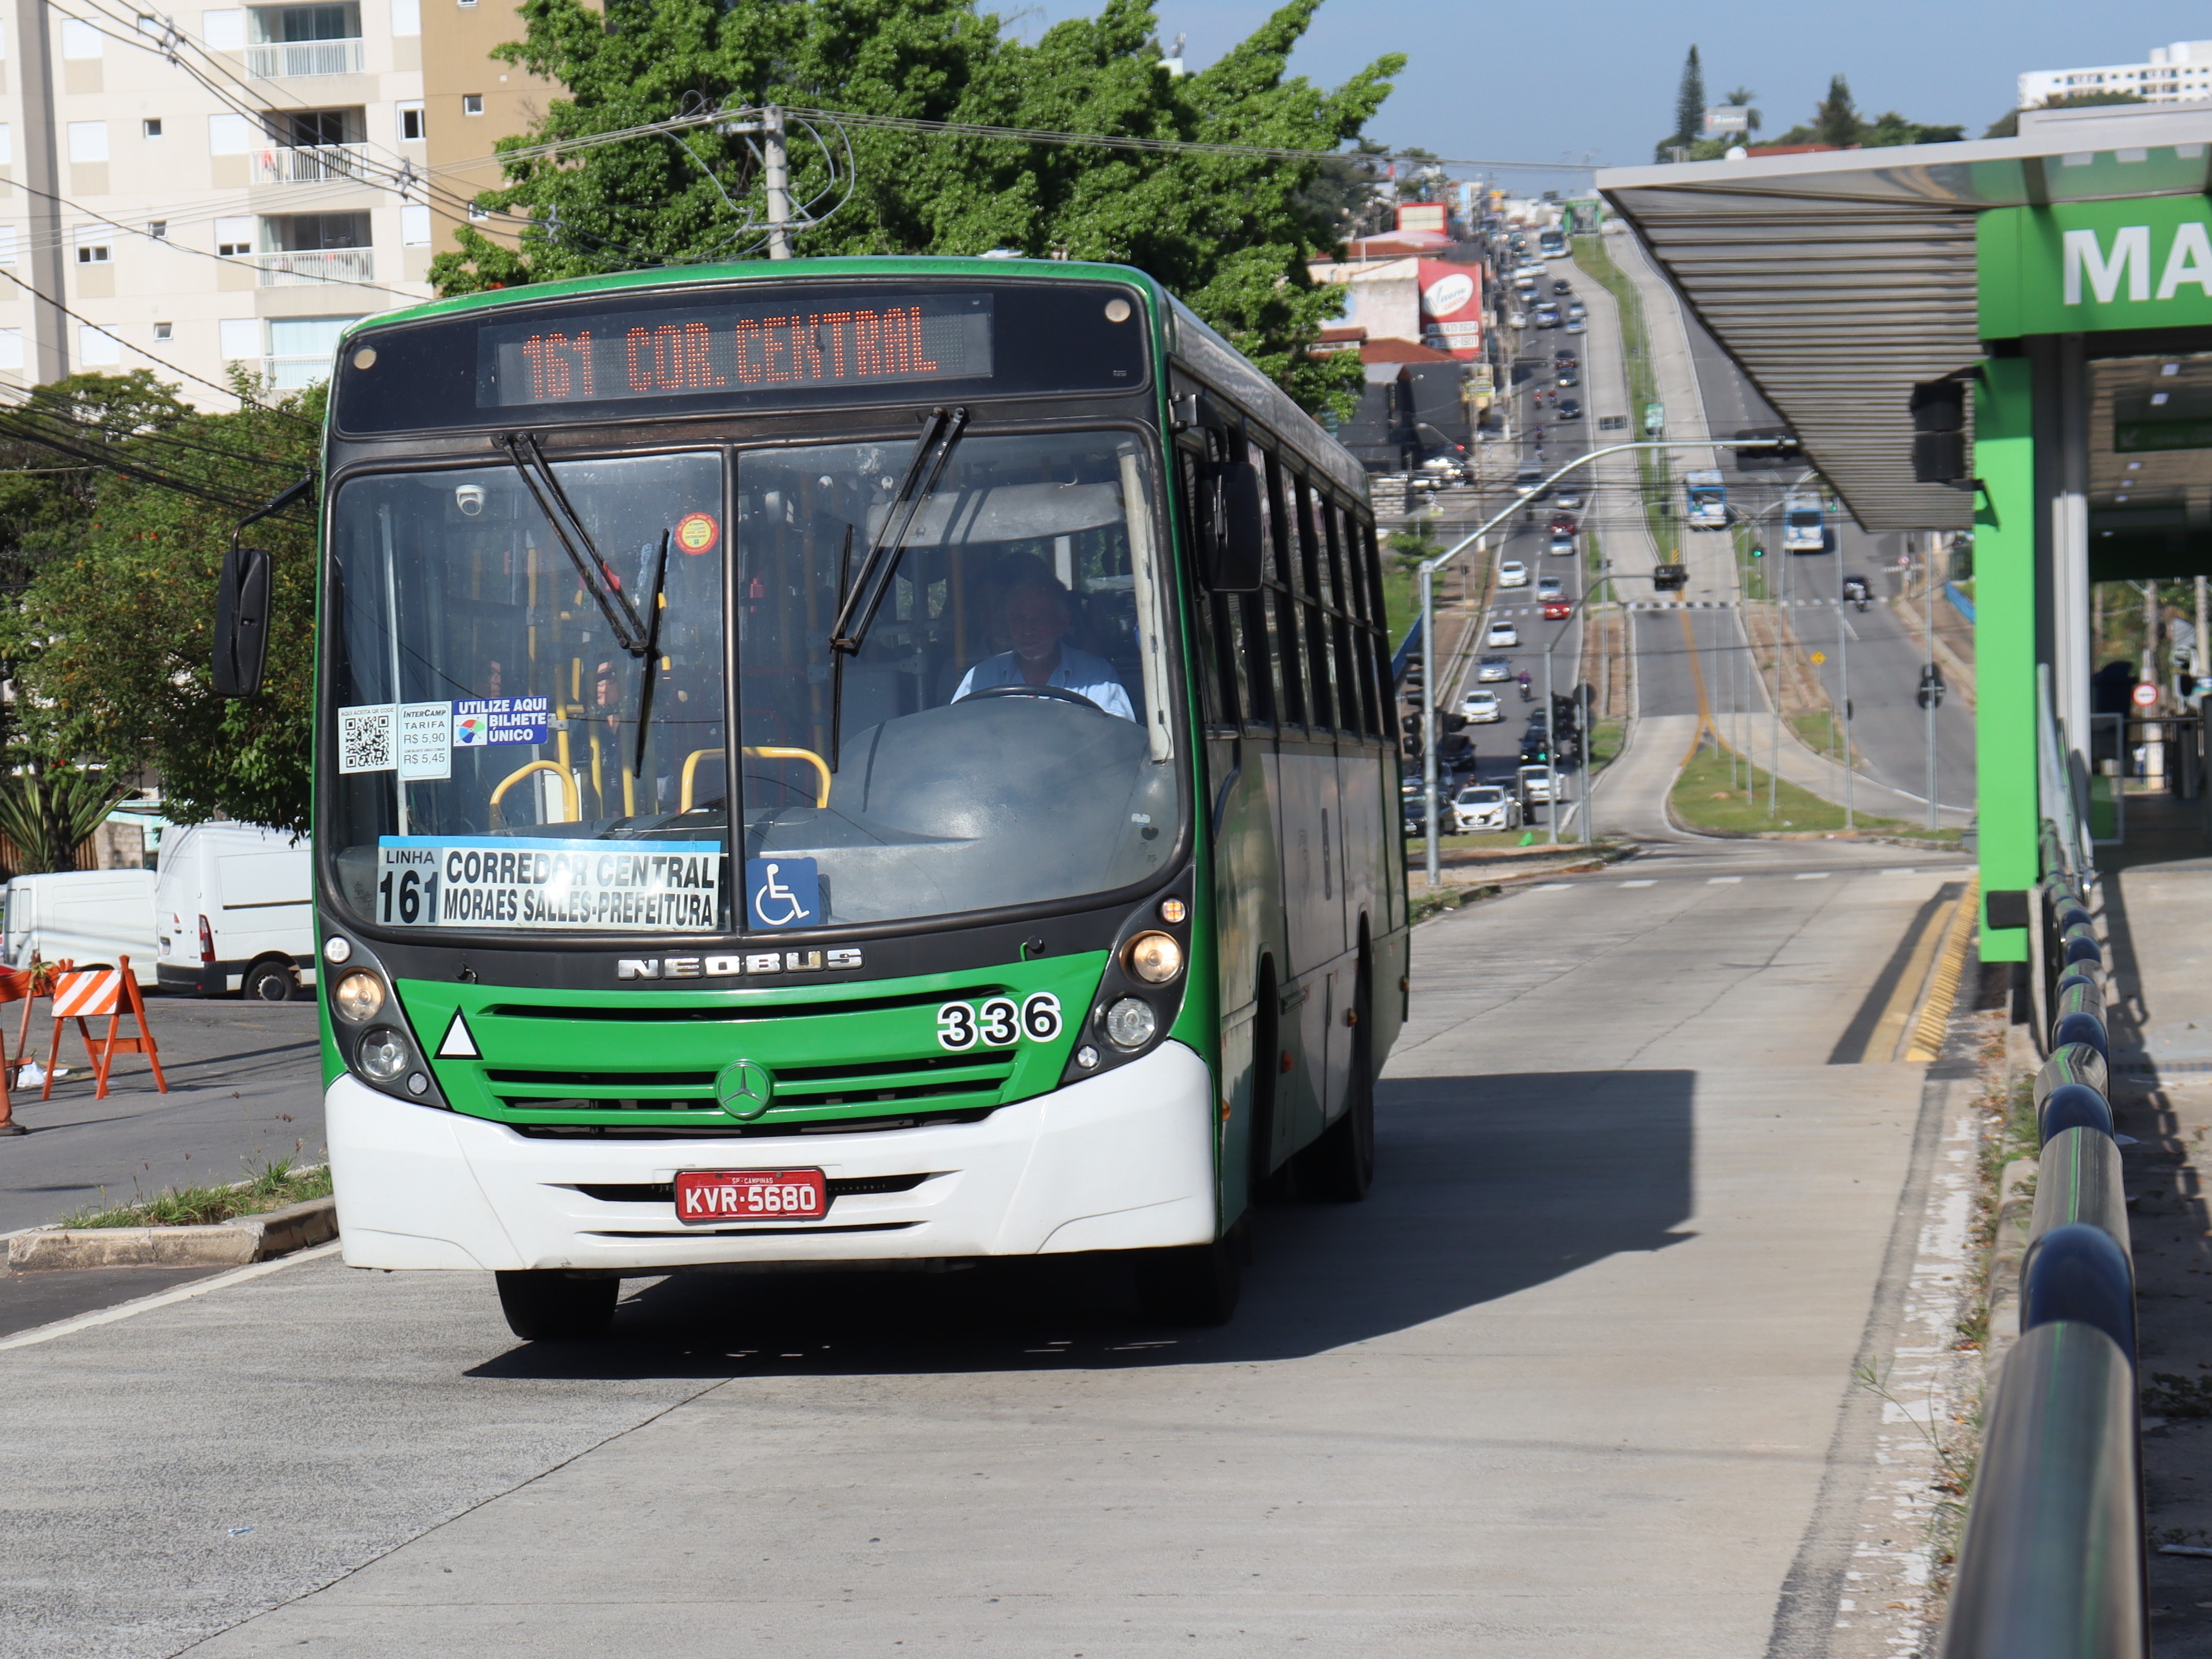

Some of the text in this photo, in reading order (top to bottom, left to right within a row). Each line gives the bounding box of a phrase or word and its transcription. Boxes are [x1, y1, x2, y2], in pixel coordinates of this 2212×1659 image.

[522, 330, 593, 397] 161
[736, 306, 937, 384] CENTRAL
[458, 697, 547, 714] UTILIZE AQUI
[404, 721, 446, 730] TARIFA
[489, 712, 546, 727] BILHETE
[404, 733, 446, 744] R$ 5,90
[489, 727, 534, 743] ÚNICO
[404, 753, 446, 765] R$ 5,45
[386, 850, 435, 864] LINHA
[446, 850, 715, 889] CORREDOR CENTRAL
[380, 870, 438, 924] 161
[443, 887, 713, 927] MORAES SALLES-PREFEITURA
[617, 948, 863, 979] NEOBUS
[938, 992, 1062, 1051] 336
